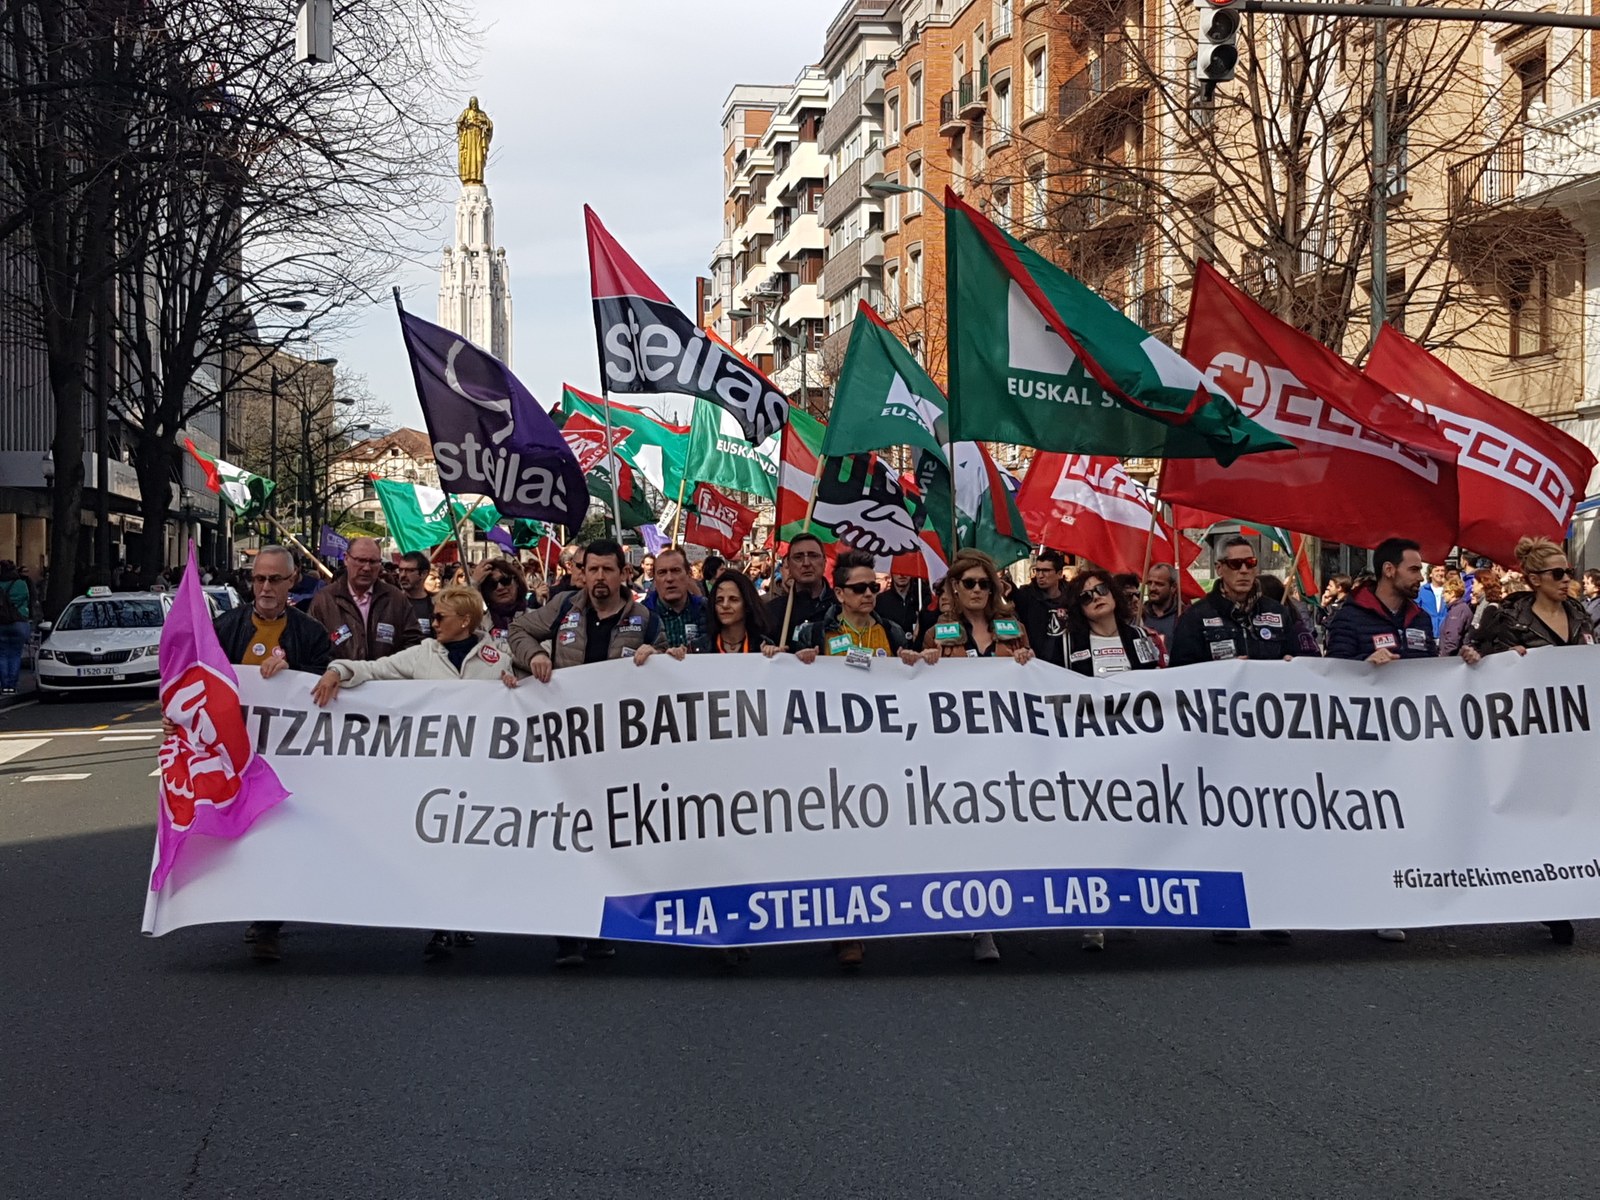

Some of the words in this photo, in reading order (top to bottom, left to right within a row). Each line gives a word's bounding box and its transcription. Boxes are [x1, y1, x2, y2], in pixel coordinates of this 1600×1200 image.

[1008, 377, 1092, 405] EUSKAL
[489, 703, 605, 763] BERRI
[619, 689, 768, 749] BATEN
[783, 689, 918, 741] ALDE,
[929, 690, 1164, 738] BENETAKO
[1175, 688, 1454, 742] NEGOZIAZIOA
[1460, 685, 1591, 740] ORAIN
[415, 788, 595, 852] Gizarte
[606, 767, 889, 849] Ekimeneko
[904, 763, 1188, 826] ikastetxeak
[1197, 766, 1405, 831] borrokan
[655, 896, 718, 936] ELA
[748, 884, 891, 930] STEILAS
[921, 878, 1013, 919] CCOO
[1043, 877, 1111, 915] LAB
[1137, 877, 1201, 915] UGT
